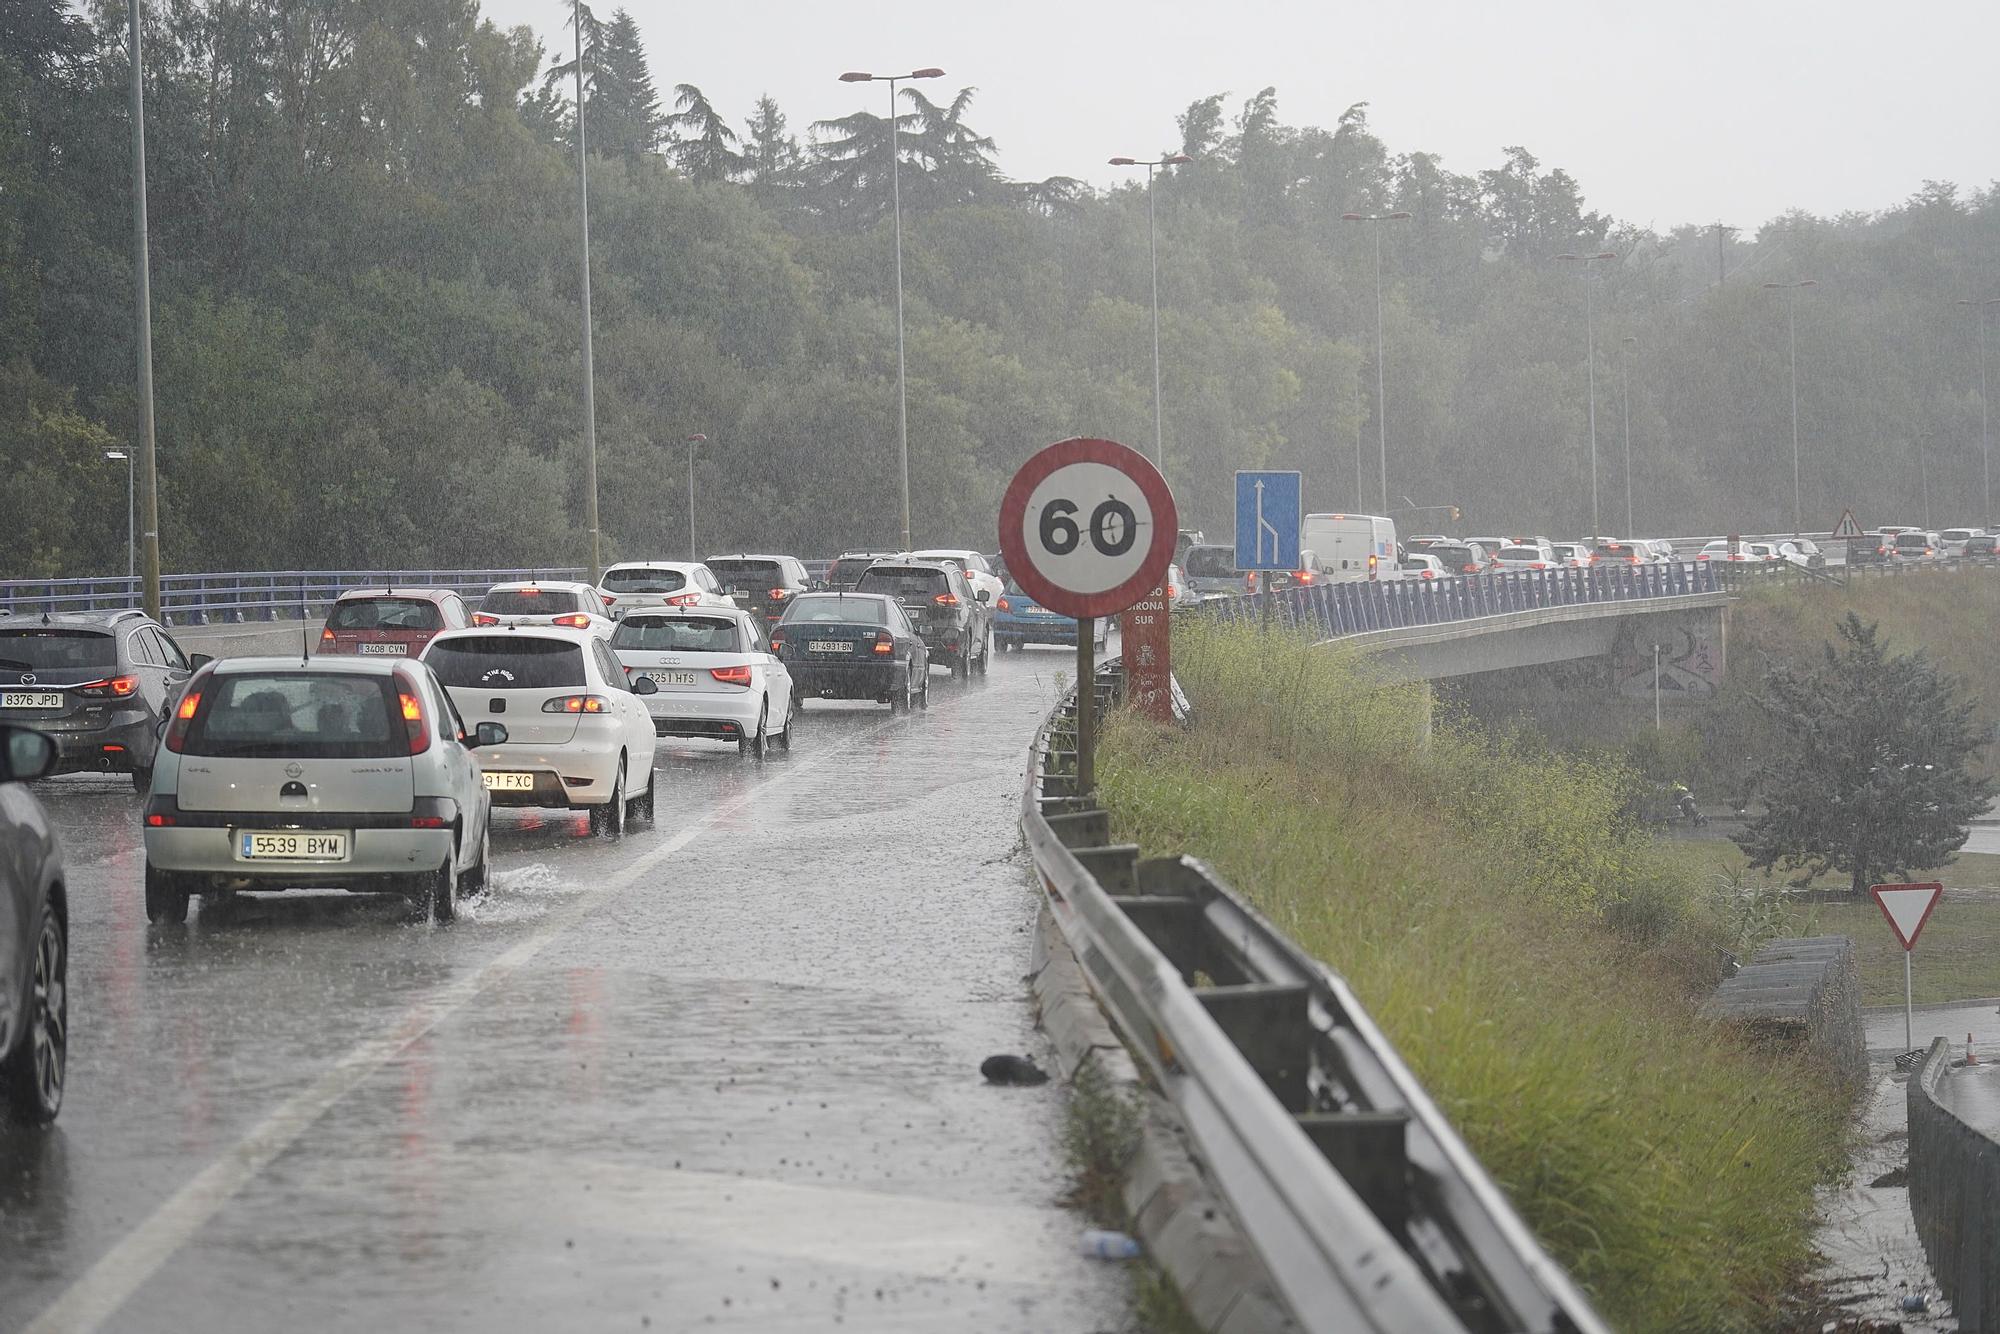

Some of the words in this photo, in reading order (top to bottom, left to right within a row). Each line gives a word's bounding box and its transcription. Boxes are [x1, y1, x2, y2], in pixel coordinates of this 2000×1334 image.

[1039, 498, 1136, 557] 60
[1135, 615, 1154, 625] SUR
[365, 643, 385, 654] 3408
[388, 643, 406, 654] CVN
[649, 672, 672, 683] 3251
[675, 672, 694, 683] HTS
[6, 694, 34, 706] 8376
[37, 694, 58, 706] JPD
[482, 775, 500, 787] 91
[506, 775, 531, 787] FXC
[256, 837, 297, 853] 5539
[307, 838, 338, 854] BYM
